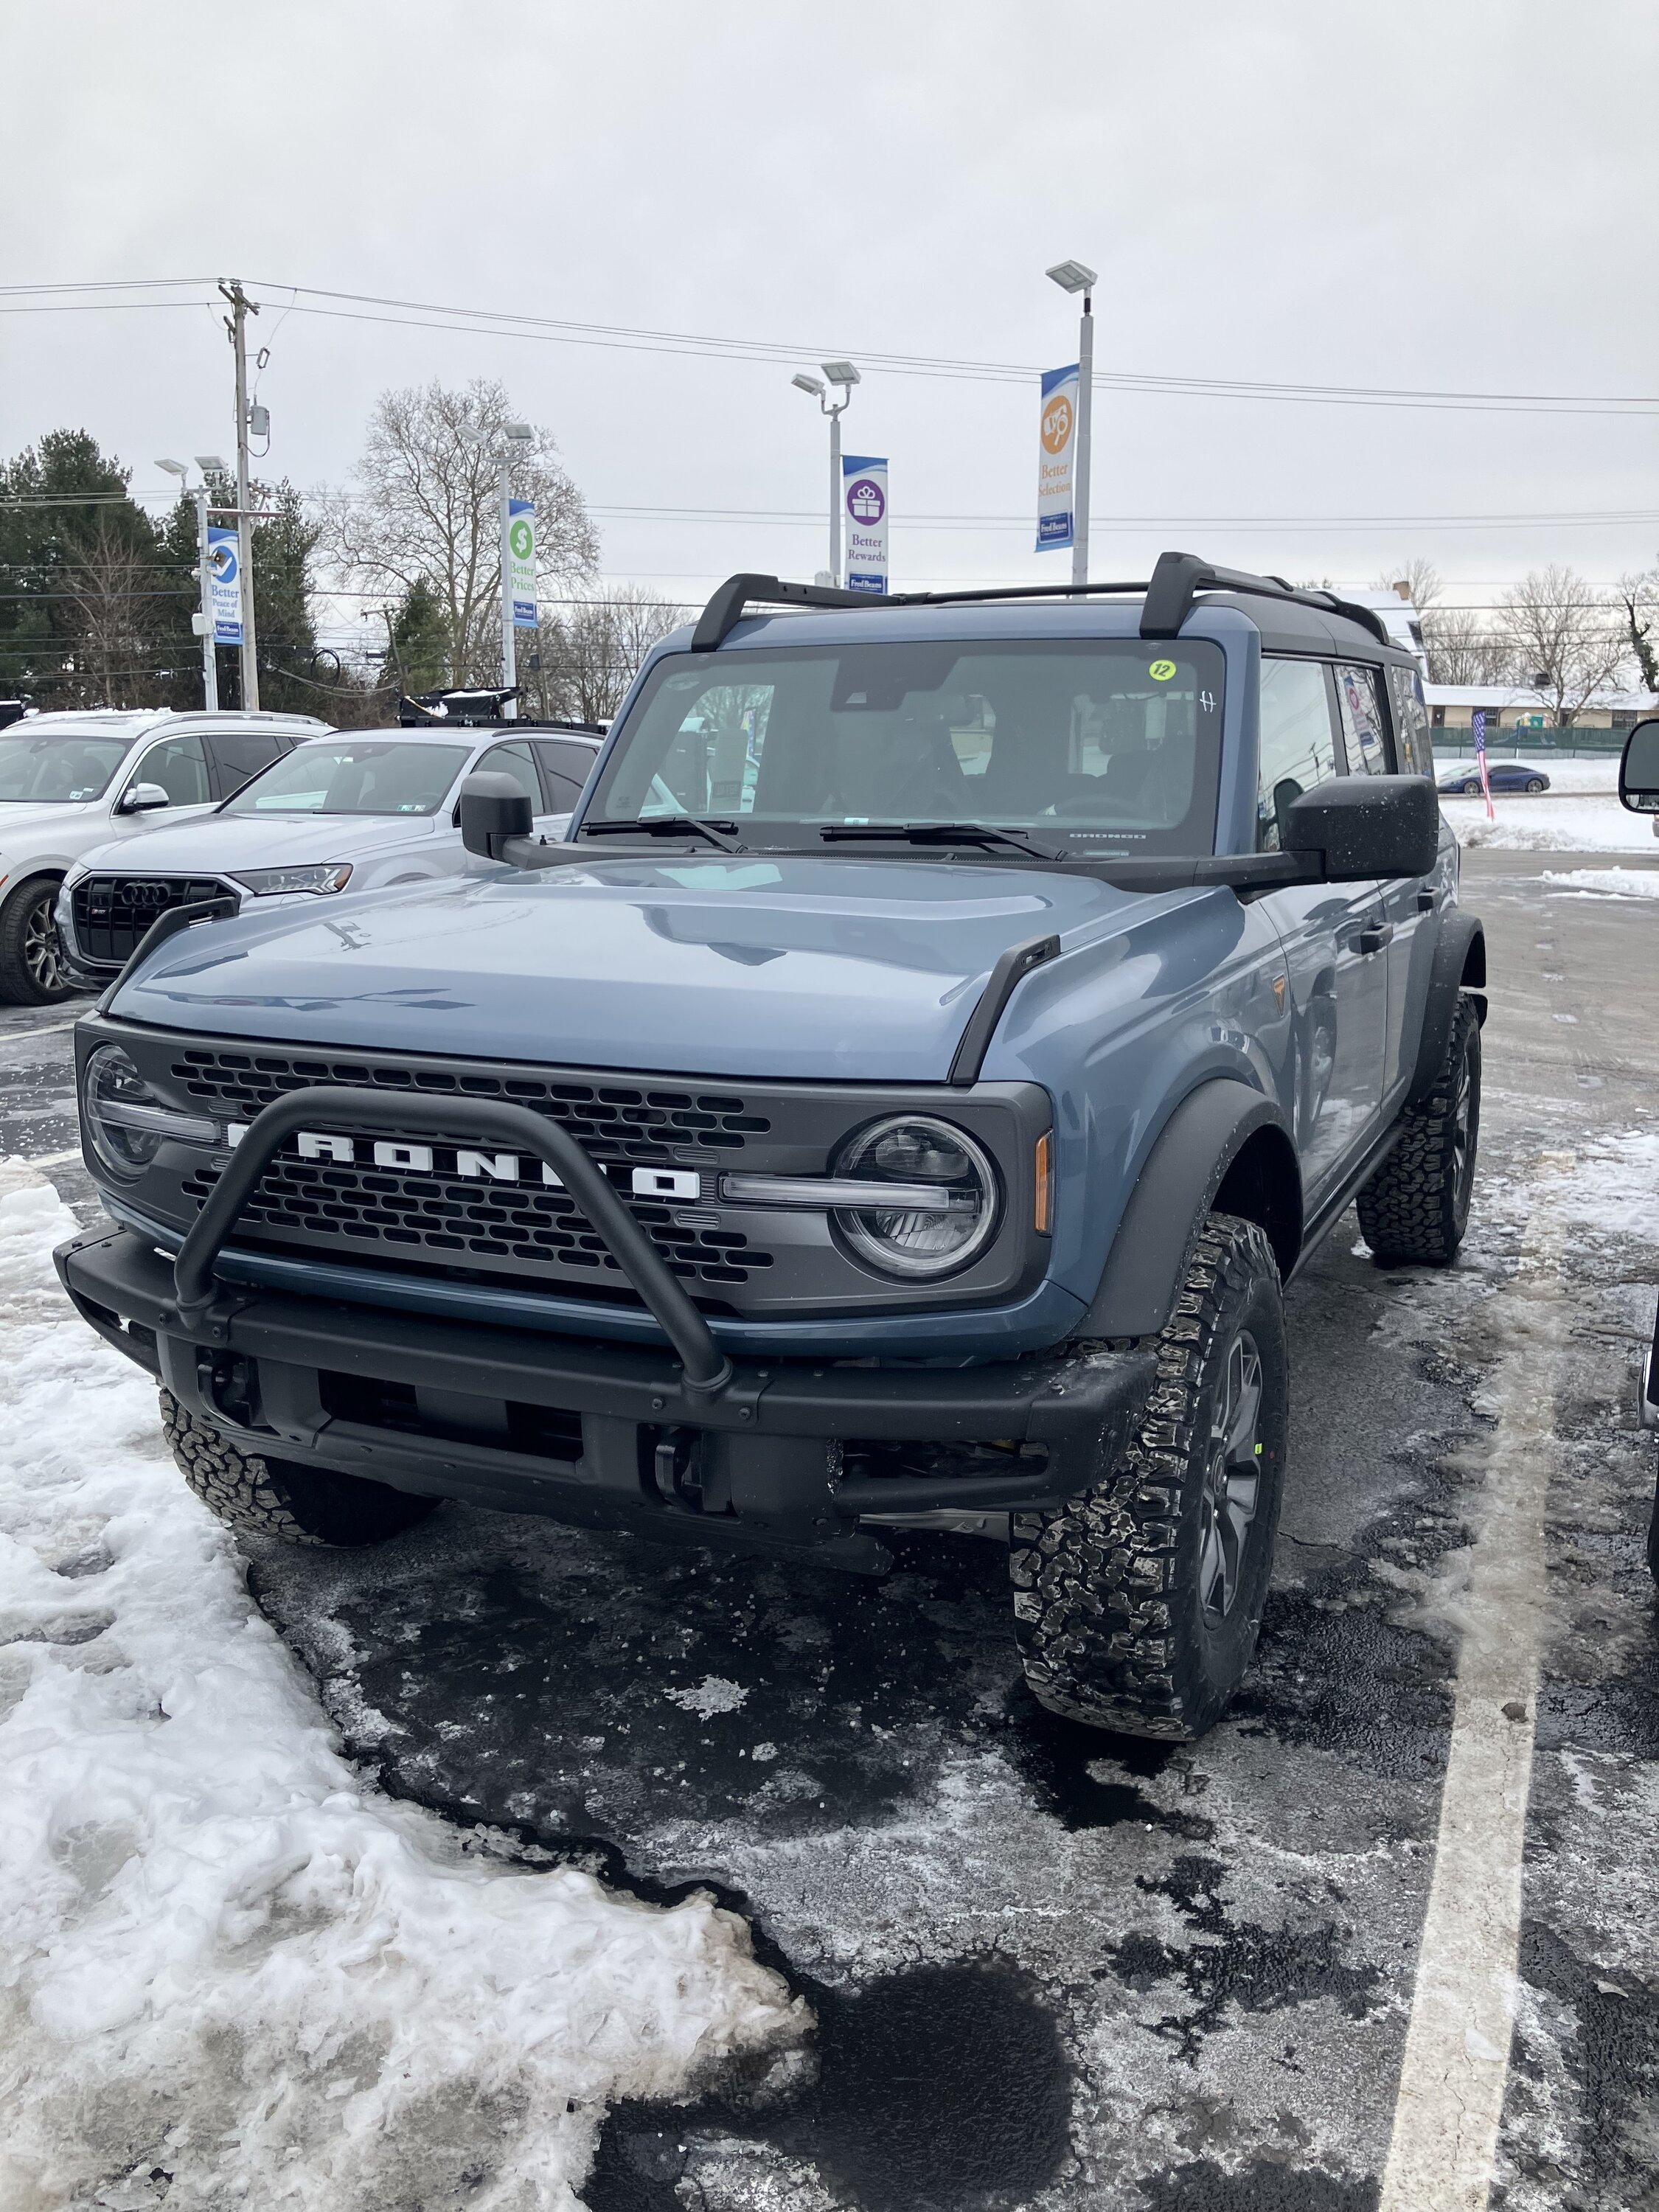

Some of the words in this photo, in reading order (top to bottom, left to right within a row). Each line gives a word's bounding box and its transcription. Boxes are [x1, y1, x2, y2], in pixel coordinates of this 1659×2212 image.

[1042, 465, 1068, 479] Better
[852, 534, 882, 548] Better
[848, 549, 886, 563] Rewards
[510, 561, 534, 576] Better
[212, 584, 240, 598] Better
[511, 577, 535, 591] Prices
[218, 608, 235, 618] Mind
[1153, 664, 1171, 677] 12
